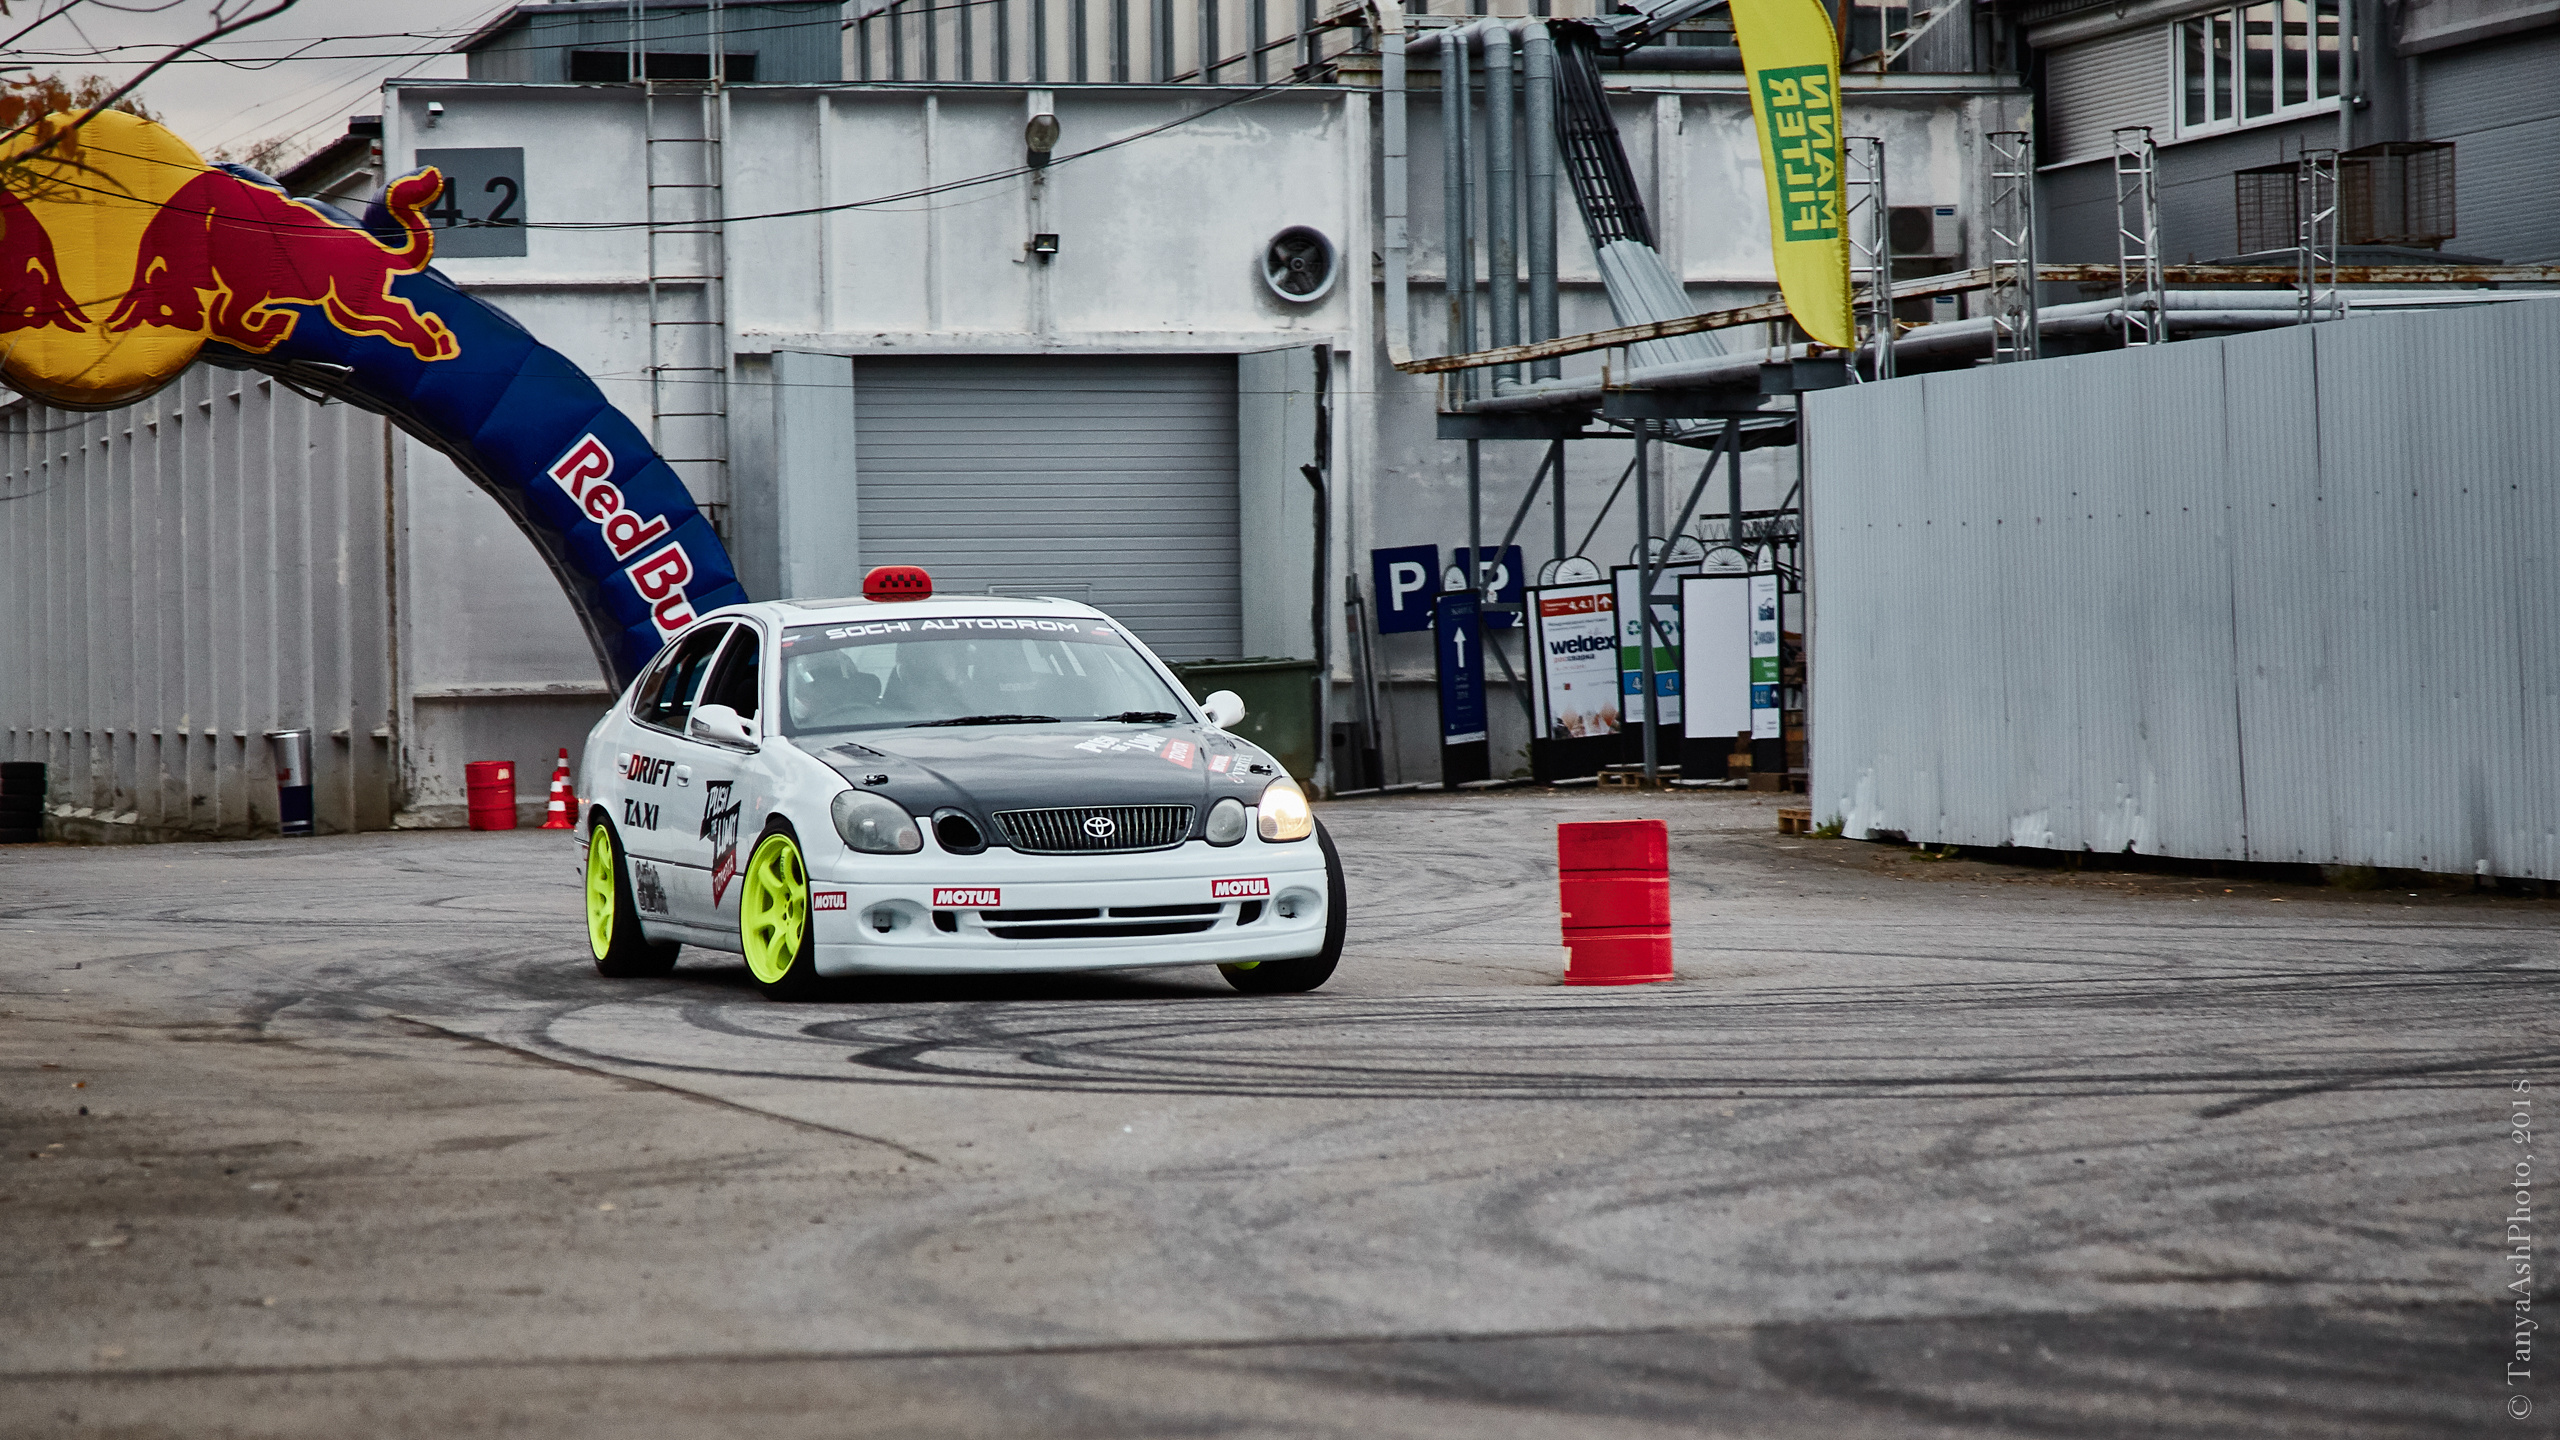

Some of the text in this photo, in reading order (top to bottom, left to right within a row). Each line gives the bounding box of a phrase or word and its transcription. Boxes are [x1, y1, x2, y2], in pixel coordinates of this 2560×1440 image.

[551, 436, 694, 638] Red Bu
[1389, 561, 1426, 611] P
[825, 618, 1080, 640] SOCHI AUTODROM
[1550, 635, 1617, 655] weldex
[627, 754, 675, 787] DRIFT
[624, 798, 659, 831] TAXI
[935, 889, 999, 906] MOTUL
[1212, 879, 1269, 897] MOTUL
[814, 893, 845, 909] MOTUL
